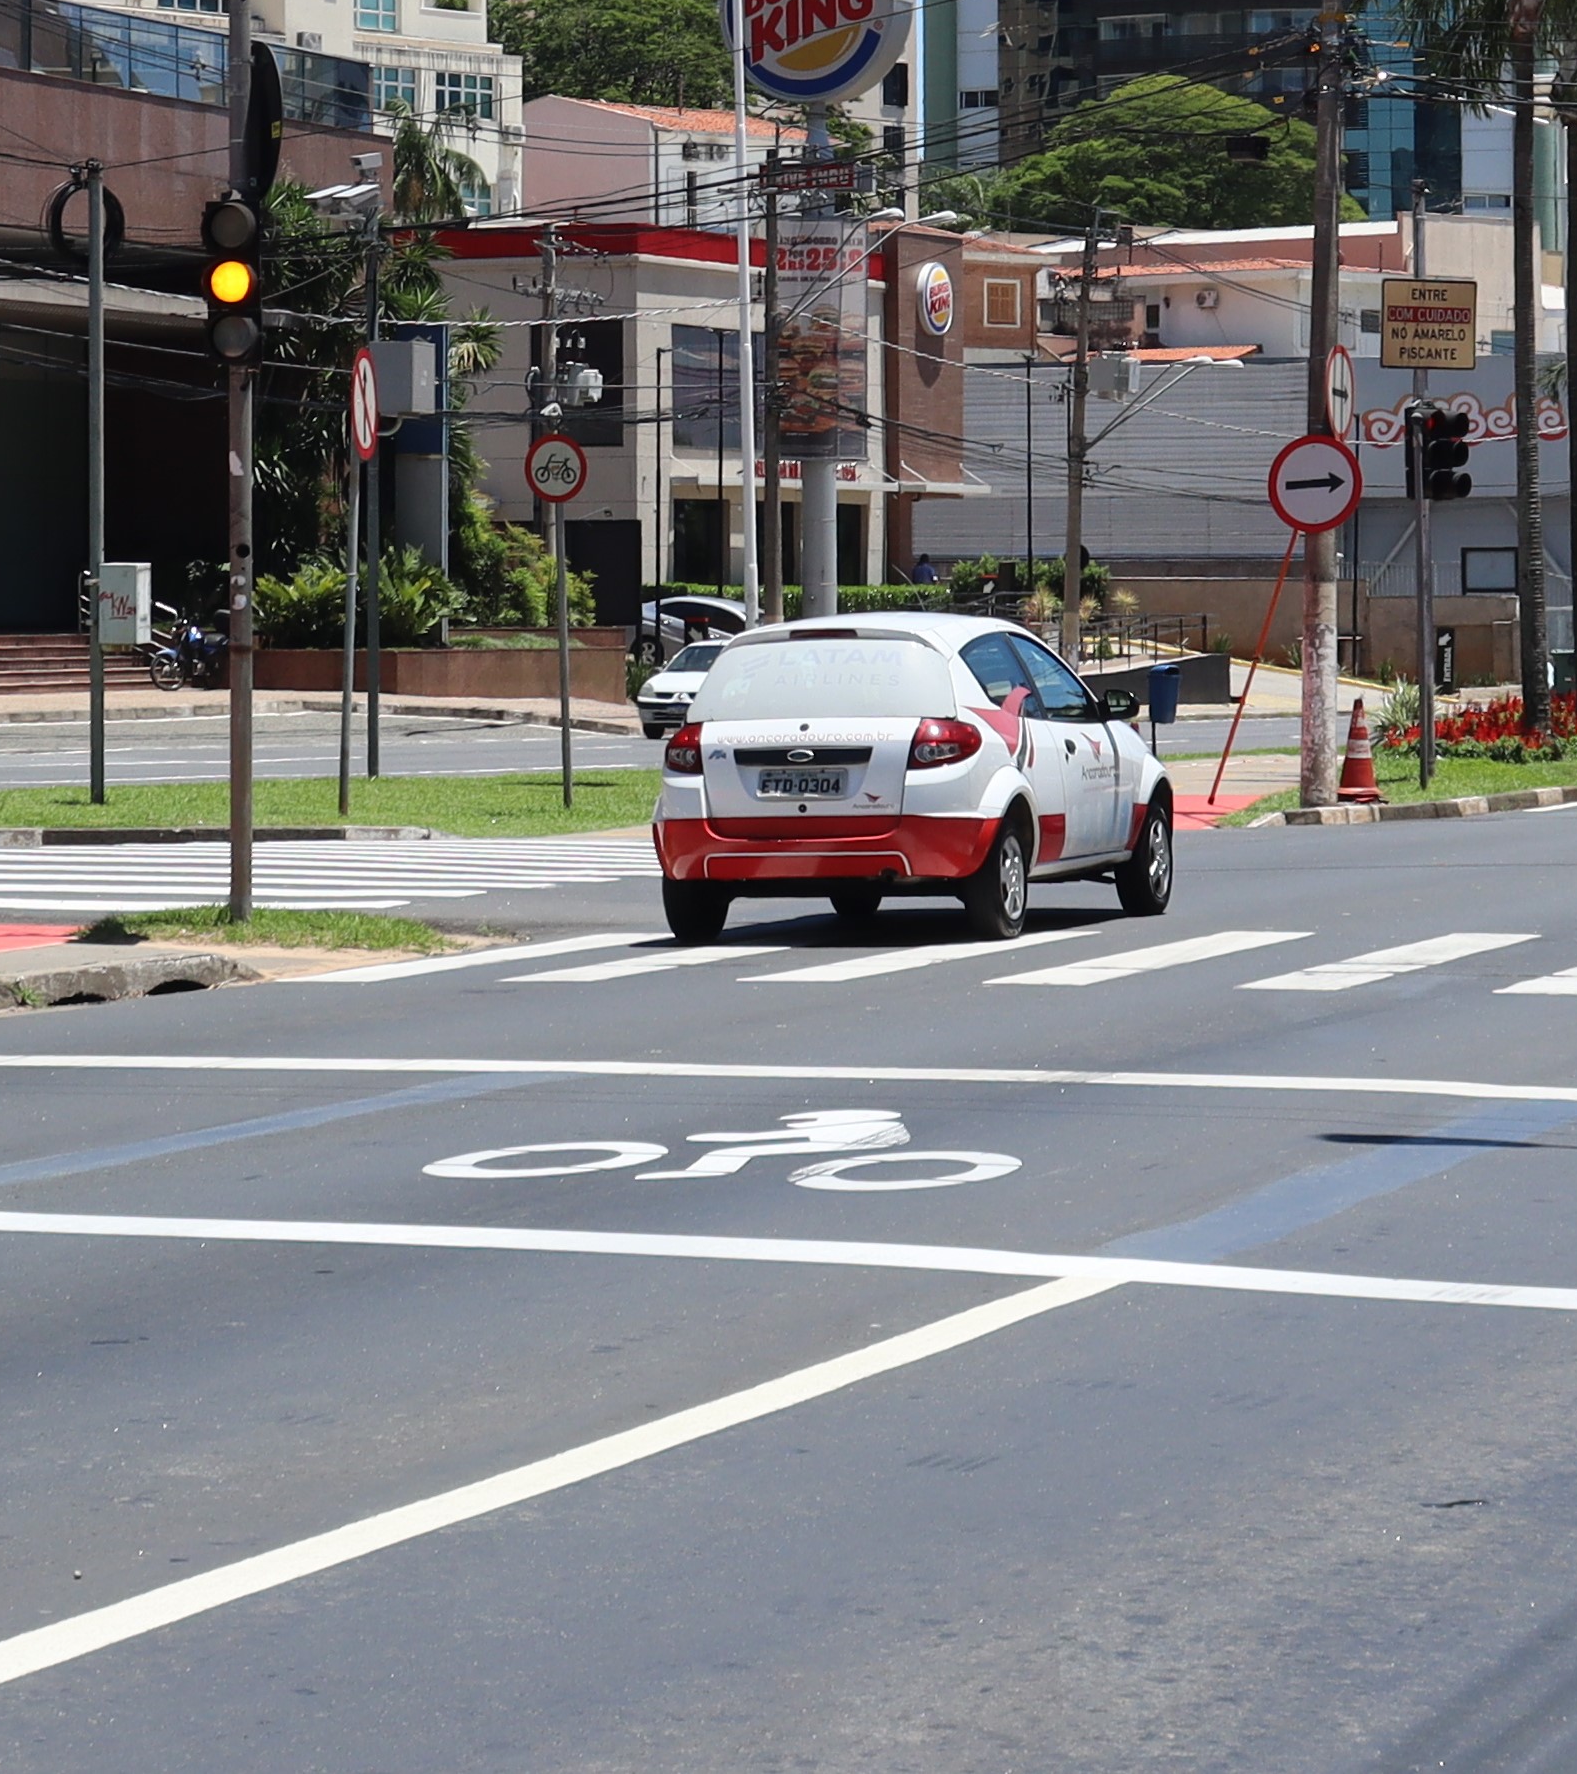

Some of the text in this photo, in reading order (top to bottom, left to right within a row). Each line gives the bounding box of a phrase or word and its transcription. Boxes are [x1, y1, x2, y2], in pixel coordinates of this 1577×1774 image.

[1411, 288, 1448, 302] ENTRE
[1388, 307, 1470, 323] COM CUIDADO
[1391, 327, 1466, 342] NO AMARELO
[1399, 347, 1457, 361] PISCANTE
